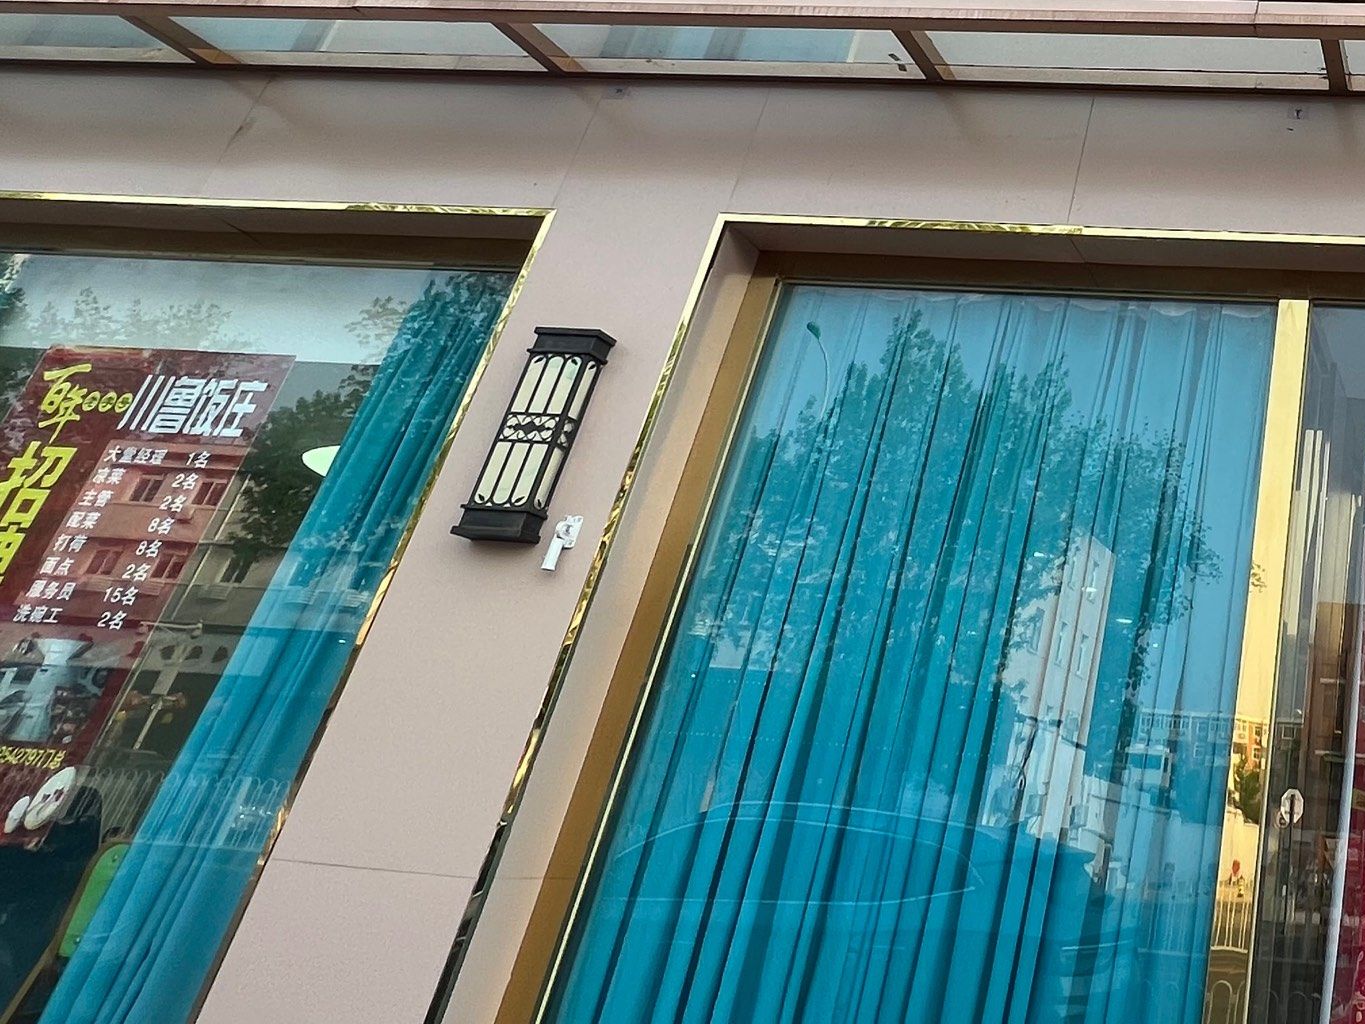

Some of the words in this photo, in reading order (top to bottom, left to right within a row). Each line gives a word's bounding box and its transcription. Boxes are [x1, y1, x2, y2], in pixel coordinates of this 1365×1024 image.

[116, 375, 268, 437] 川鲁饭庄
[104, 446, 169, 465] 大堂经理
[186, 451, 211, 468] 1名
[171, 473, 199, 490] 2名
[78, 490, 114, 507] 主管
[159, 495, 188, 513] 2名
[66, 511, 102, 530] 配菜
[148, 518, 175, 535] 8名
[53, 533, 89, 552] 打荷
[136, 539, 162, 558] 8名
[39, 556, 75, 576] 面点
[122, 563, 151, 582] 2名
[26, 579, 77, 601] 服务员
[103, 587, 139, 606] 15名
[12, 604, 63, 624] 洗碗工
[97, 611, 127, 630] 2名
